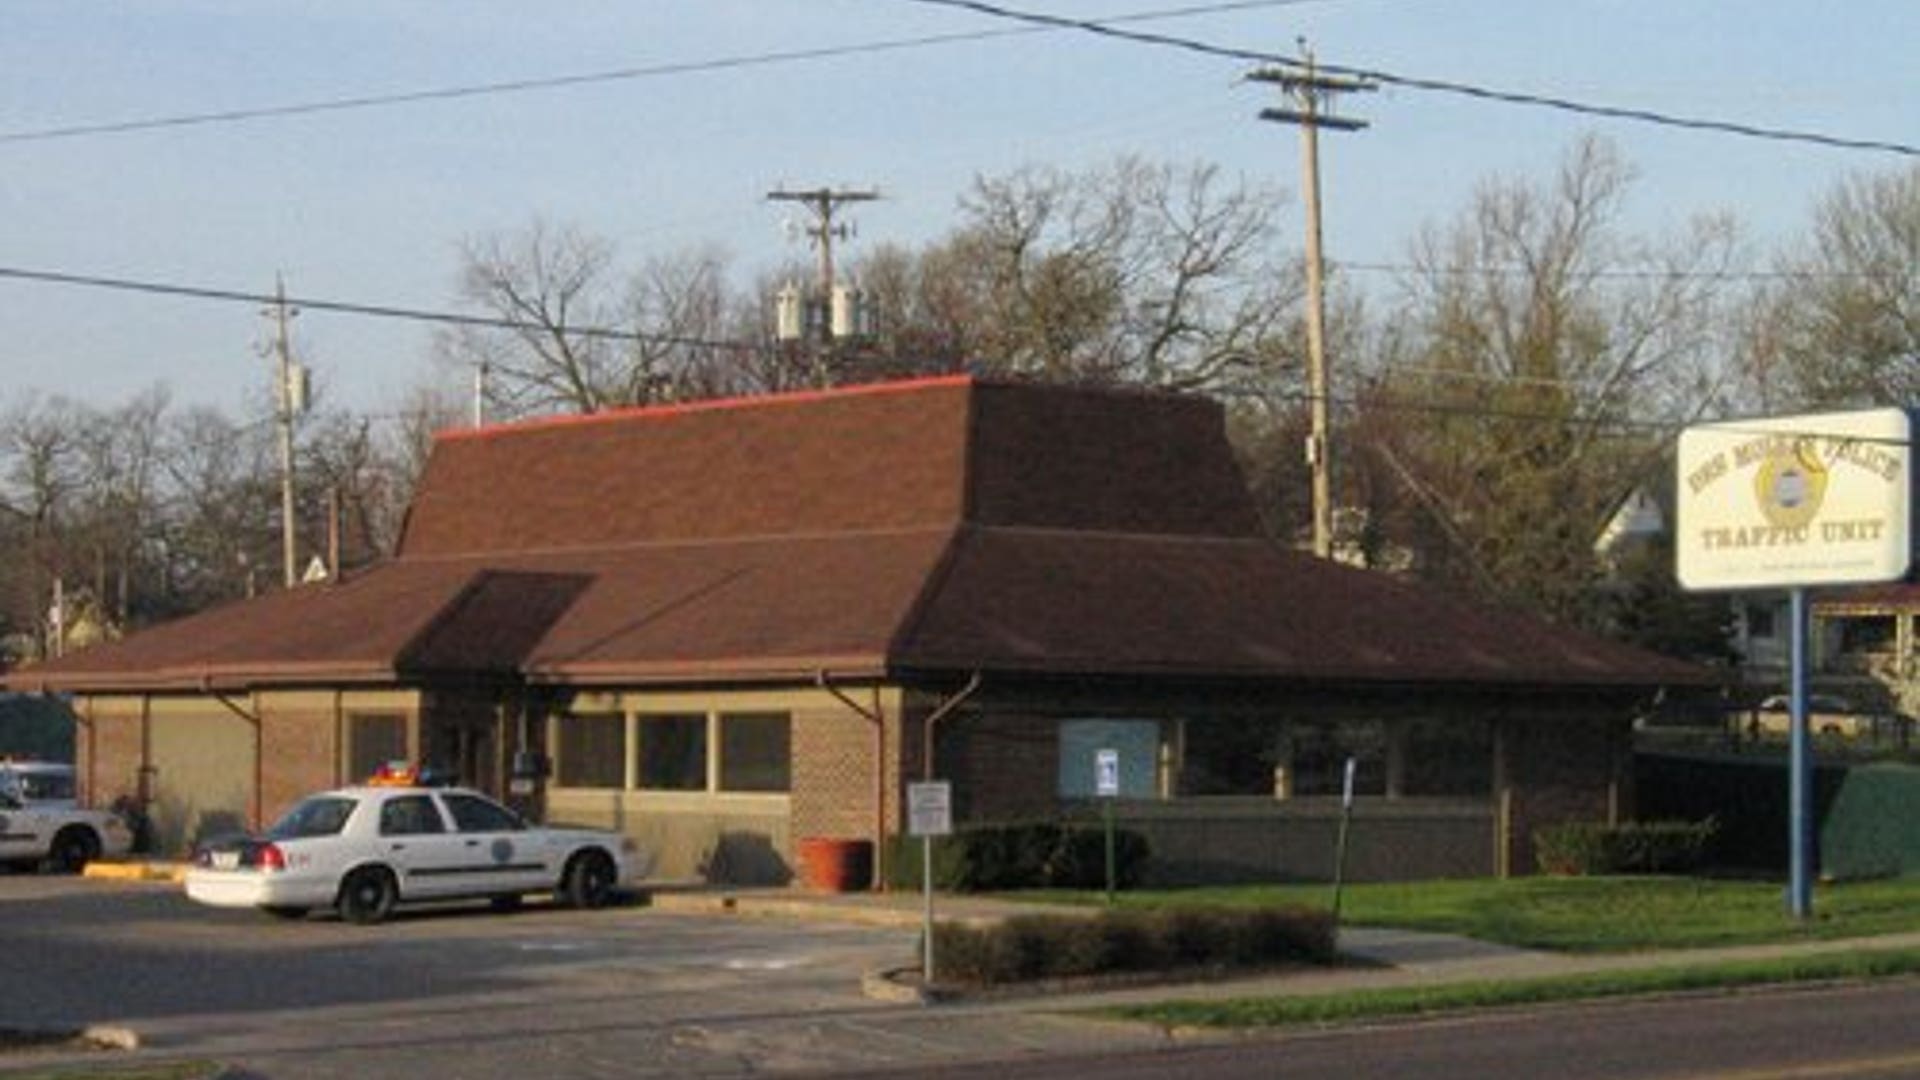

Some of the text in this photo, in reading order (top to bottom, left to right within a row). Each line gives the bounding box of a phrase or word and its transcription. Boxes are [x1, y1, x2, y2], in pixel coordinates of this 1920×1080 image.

[1732, 435, 1816, 469] MOI
[1701, 518, 1884, 550] TRAFFIC UNIT
